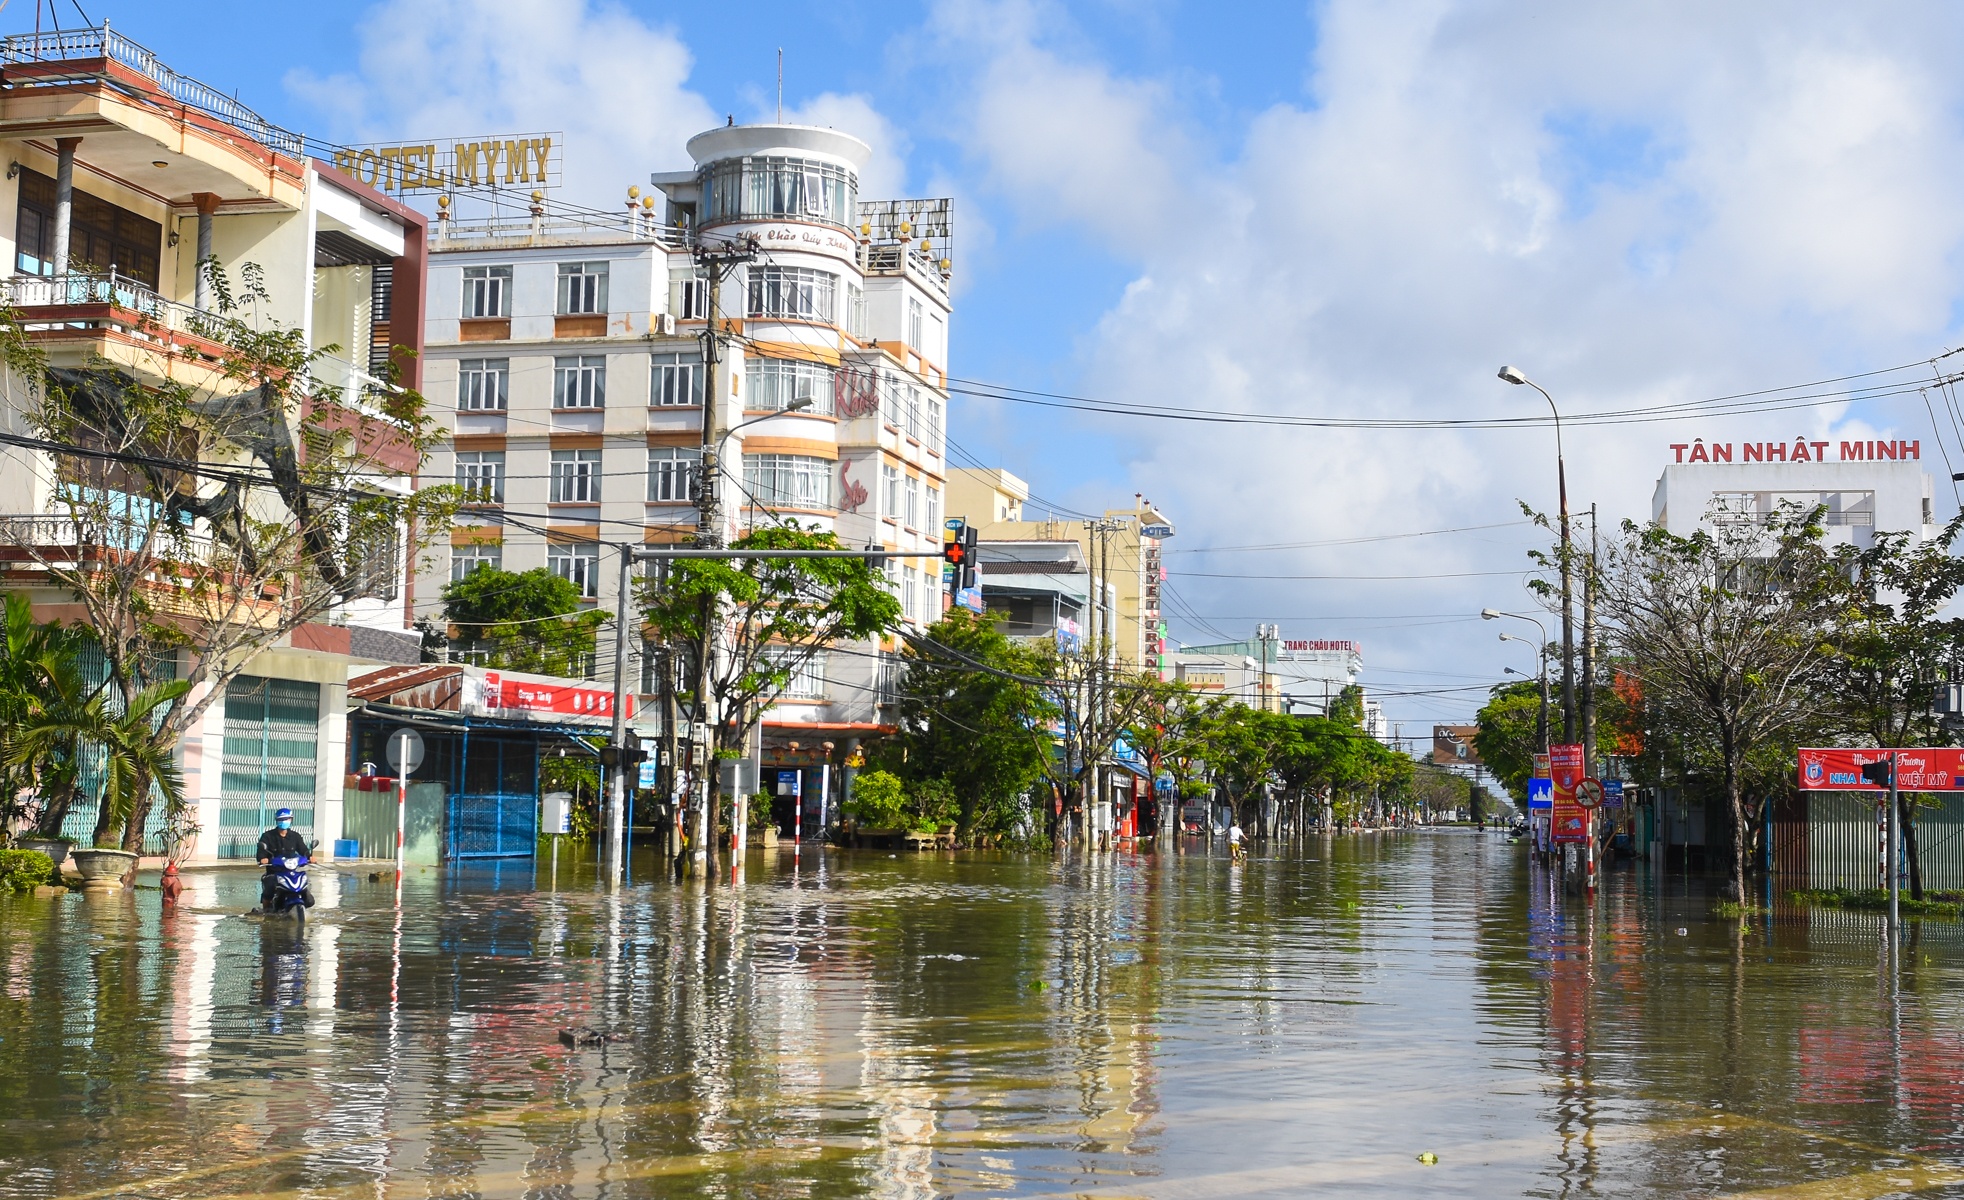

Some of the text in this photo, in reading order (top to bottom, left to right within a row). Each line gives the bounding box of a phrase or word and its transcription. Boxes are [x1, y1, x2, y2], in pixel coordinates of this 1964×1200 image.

[334, 137, 552, 190] HOTEL MYMY
[1670, 436, 1919, 463] TÂN NHẬT MINH
[1140, 526, 1174, 536] HOTEL
[1284, 639, 1352, 650] TRANG CHÂU HOTEL
[1829, 773, 1857, 784] NHA
[1899, 771, 1925, 788] VIỆT
[1927, 771, 1948, 786] MỸ
